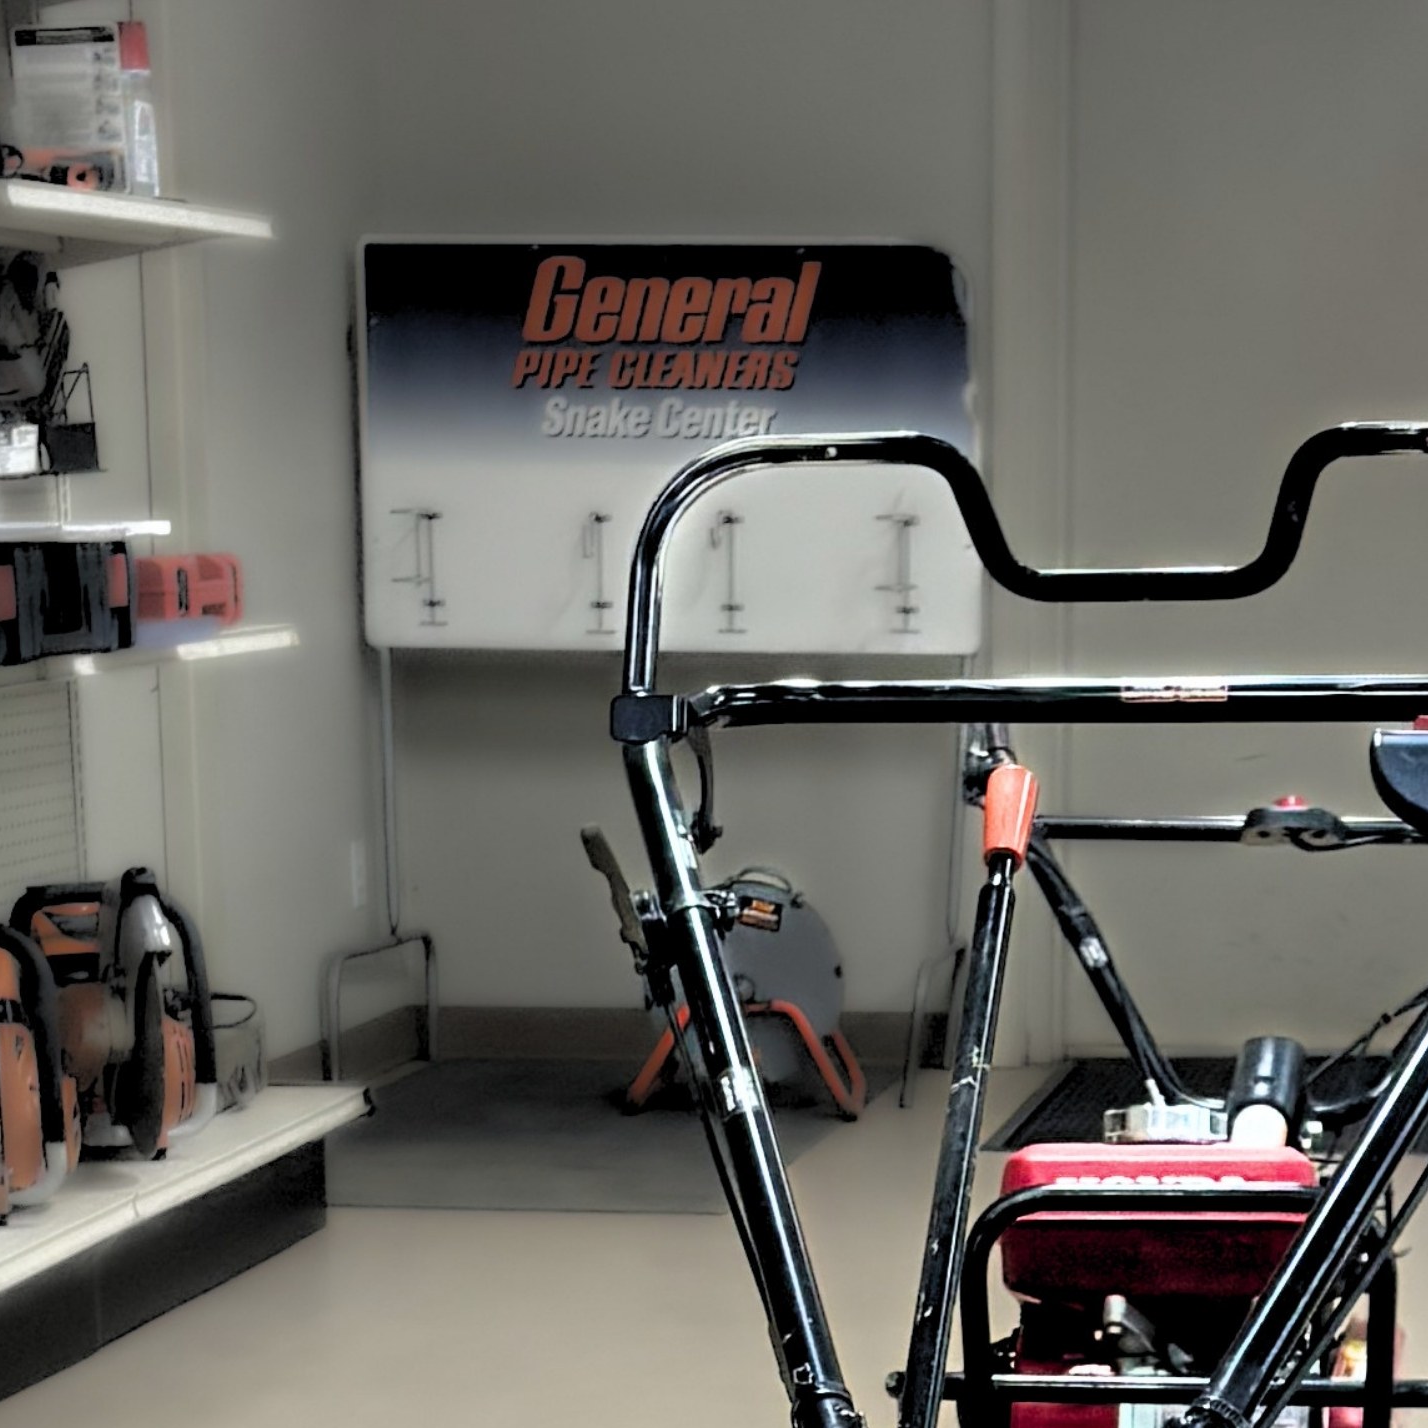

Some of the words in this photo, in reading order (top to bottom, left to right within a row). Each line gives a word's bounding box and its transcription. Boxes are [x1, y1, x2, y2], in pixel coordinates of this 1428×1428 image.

[522, 255, 822, 343] General
[513, 351, 602, 390] PIPE
[608, 351, 801, 390] CLEANERS
[542, 396, 652, 438] Snake
[657, 397, 778, 438] Center
